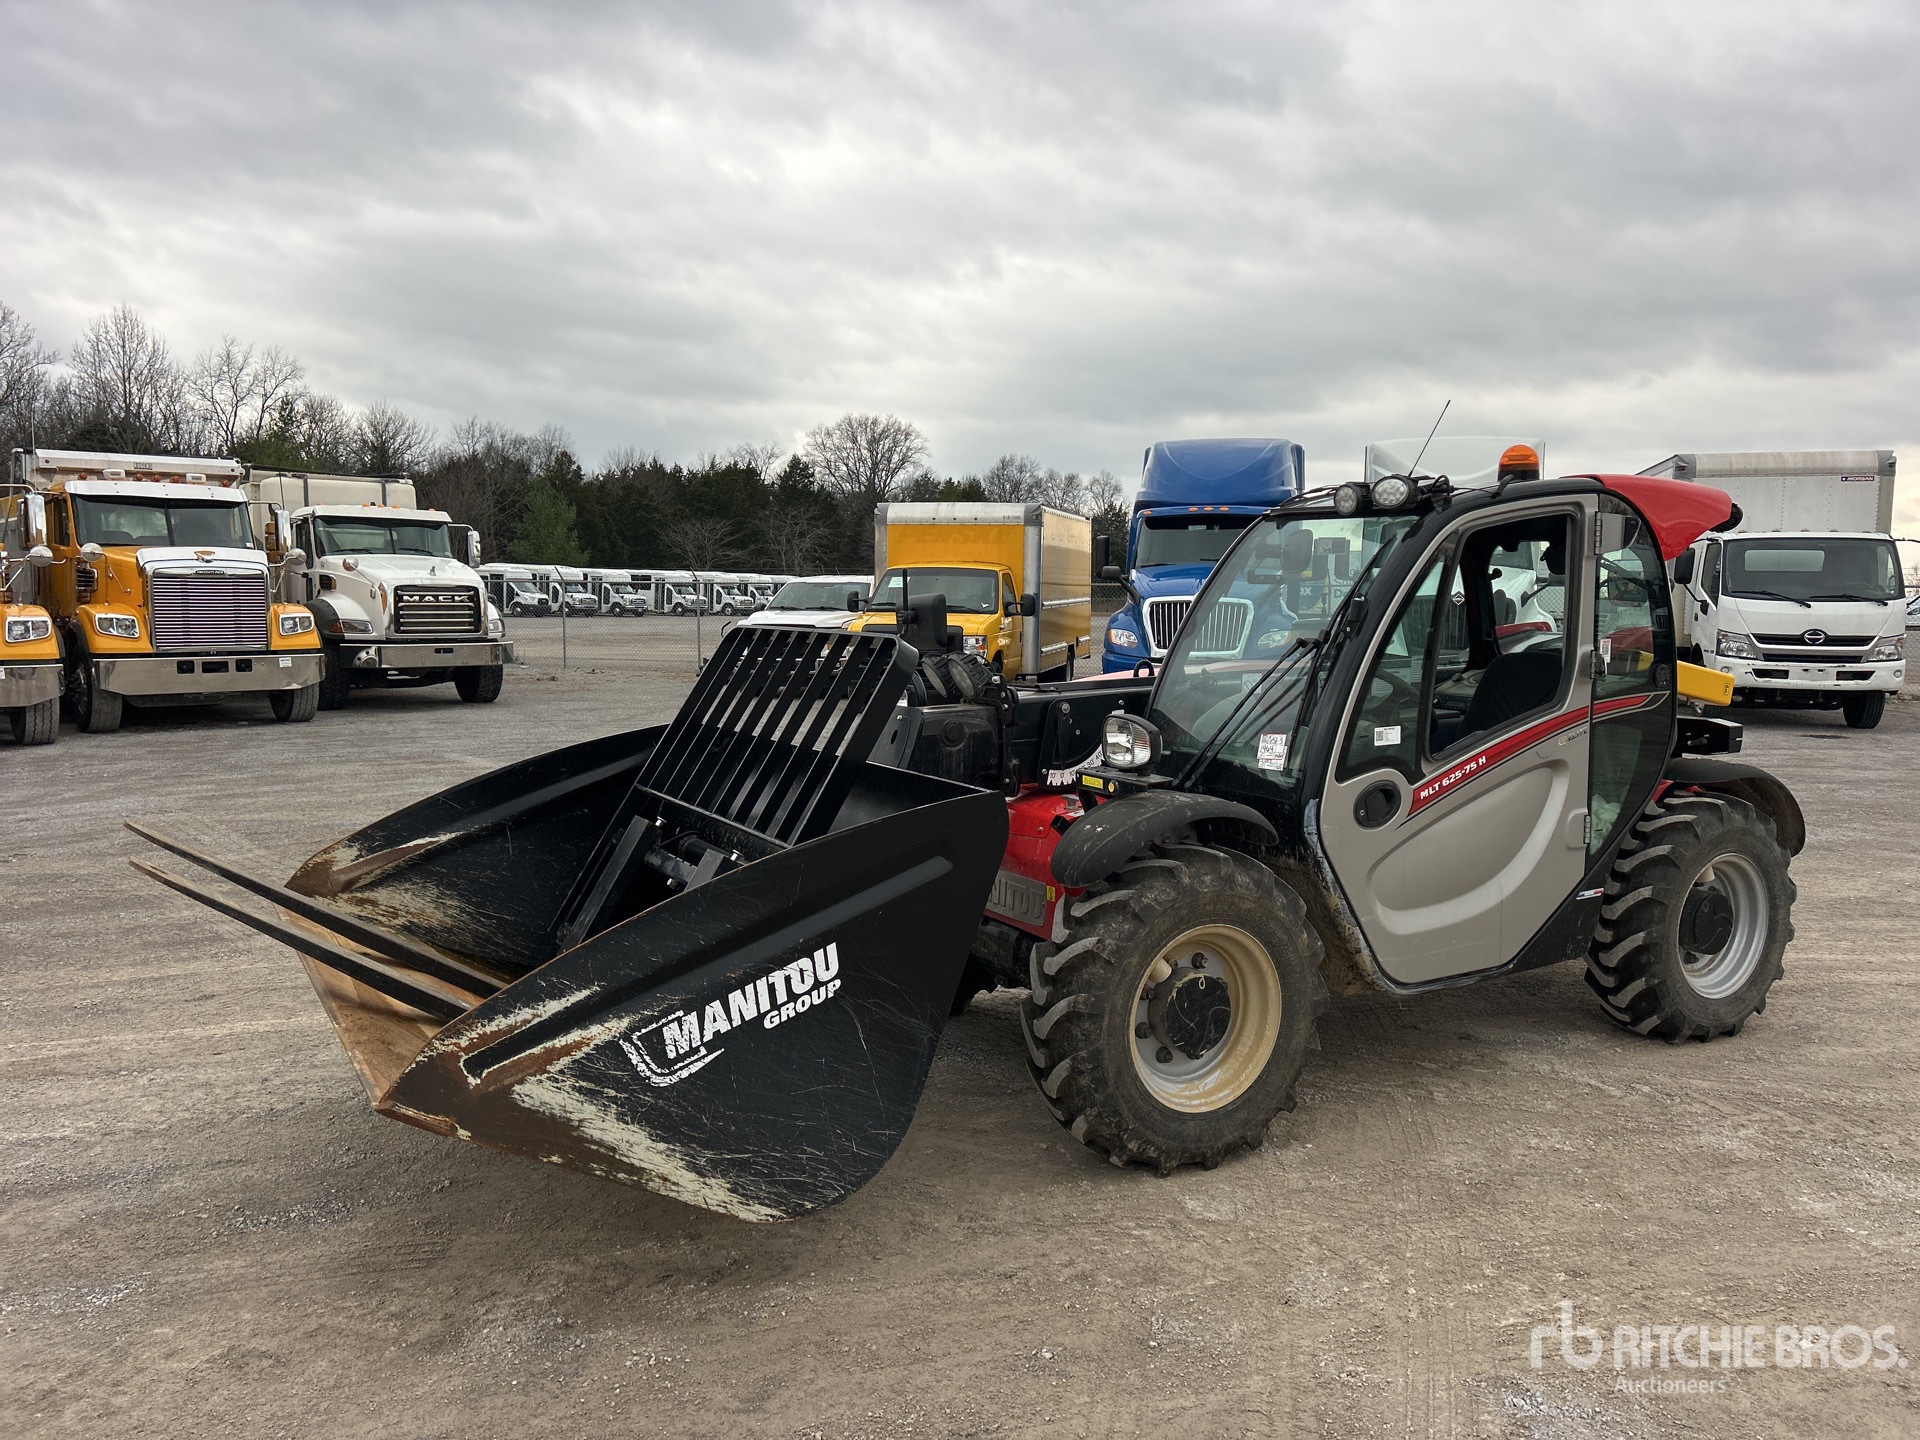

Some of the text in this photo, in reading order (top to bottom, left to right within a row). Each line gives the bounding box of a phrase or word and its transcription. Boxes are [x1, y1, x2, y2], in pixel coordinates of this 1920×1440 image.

[895, 524, 1010, 544] PENSKE
[1420, 755, 1487, 800] MLT 625-75 H
[662, 941, 840, 1060] MANITOU
[763, 978, 842, 1029] GROUP
